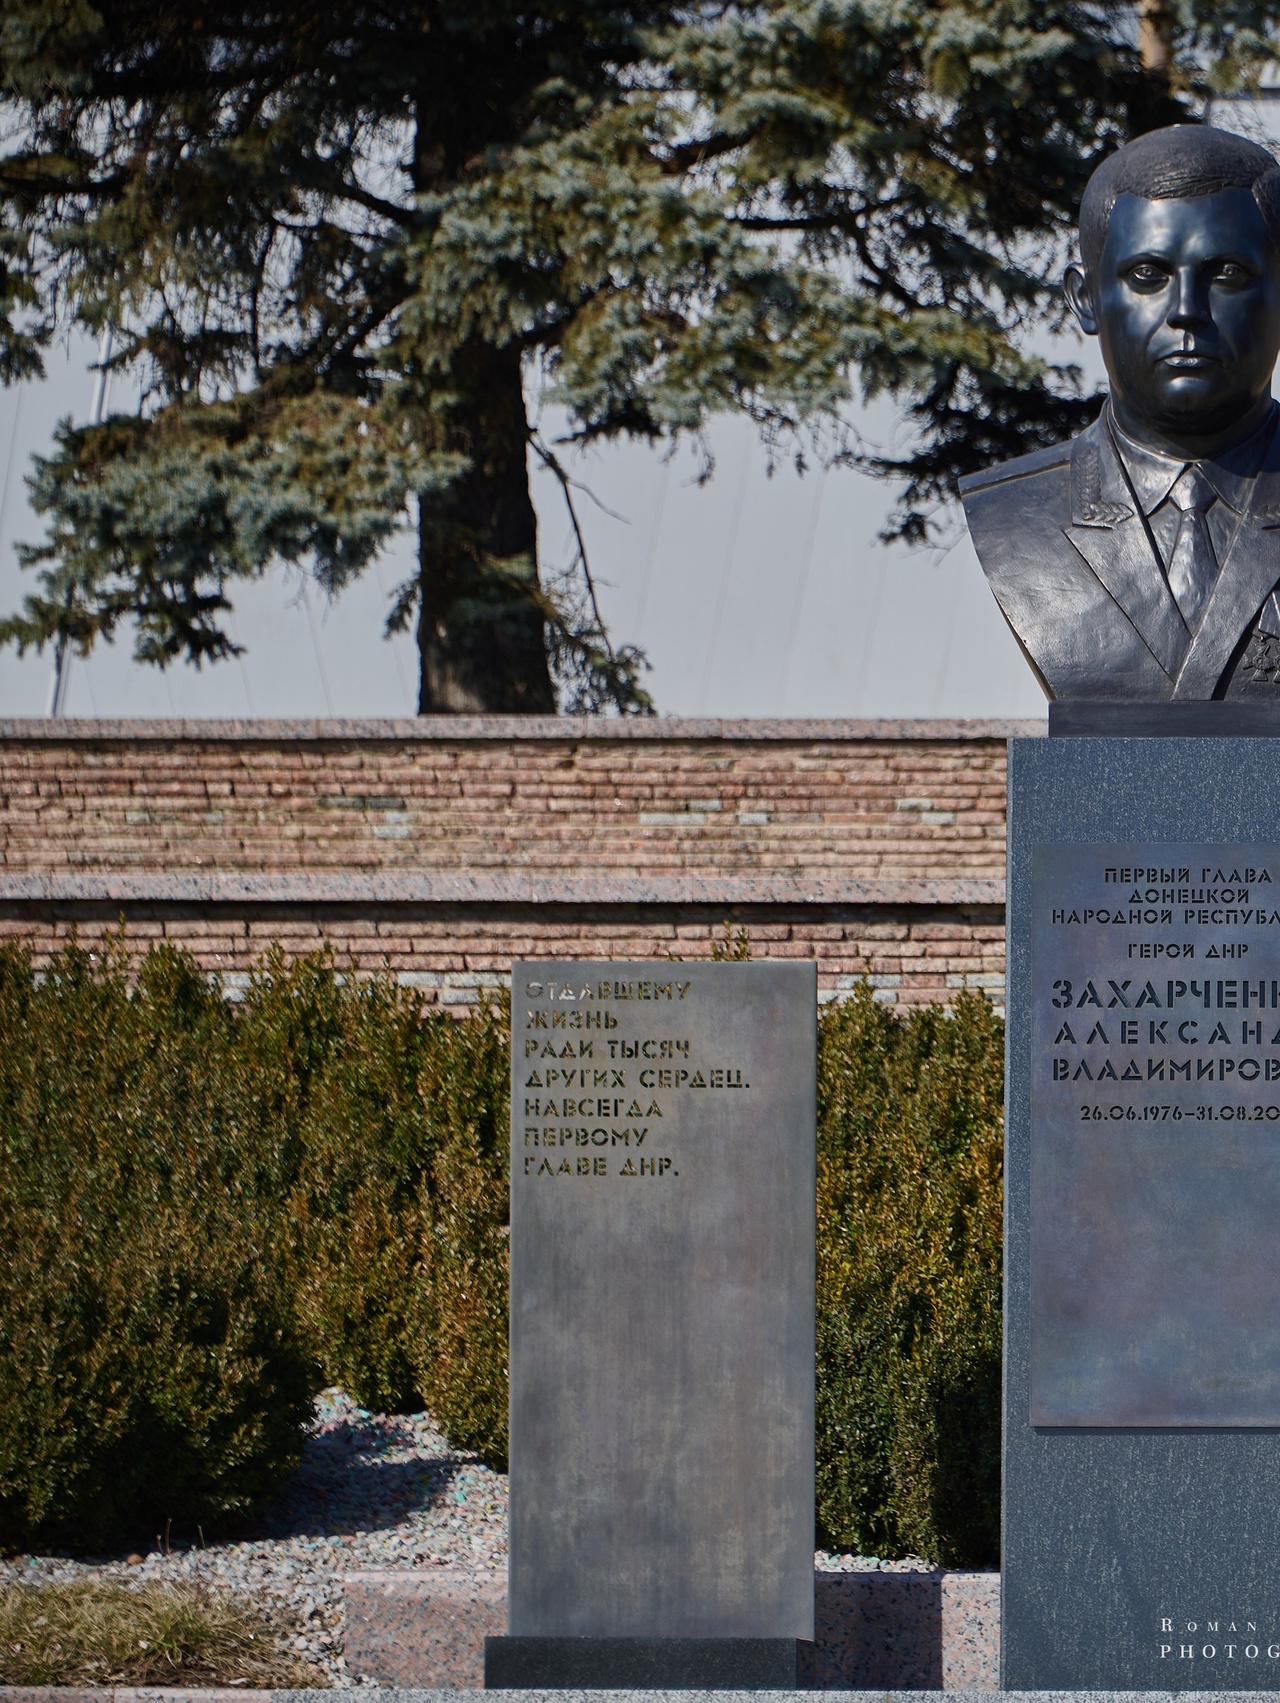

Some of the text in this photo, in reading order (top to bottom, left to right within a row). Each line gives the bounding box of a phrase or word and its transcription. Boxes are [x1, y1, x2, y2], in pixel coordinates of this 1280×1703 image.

[1104, 868, 1273, 883] ПЕРВЫЙ ГЛАВА
[1128, 888, 1250, 904] ДОНЕЦКОЙ
[1051, 909, 1173, 925] НАРОДНОЙ
[1128, 943, 1249, 959] ГЕРОЙ ДНР
[525, 981, 692, 1001] ОТДАВШЕМУ
[526, 1010, 618, 1030] ЖИЗНЬ
[525, 1039, 691, 1059] РАДИ ТЫСЯЧ
[524, 1069, 751, 1089] ДРУГИХ СЕРДЕЦ.
[524, 1098, 664, 1118] НАВСЕГДА
[524, 1127, 649, 1147] ПЕРВОМУ
[524, 1157, 679, 1177] ГЛАВЕ ДНР.
